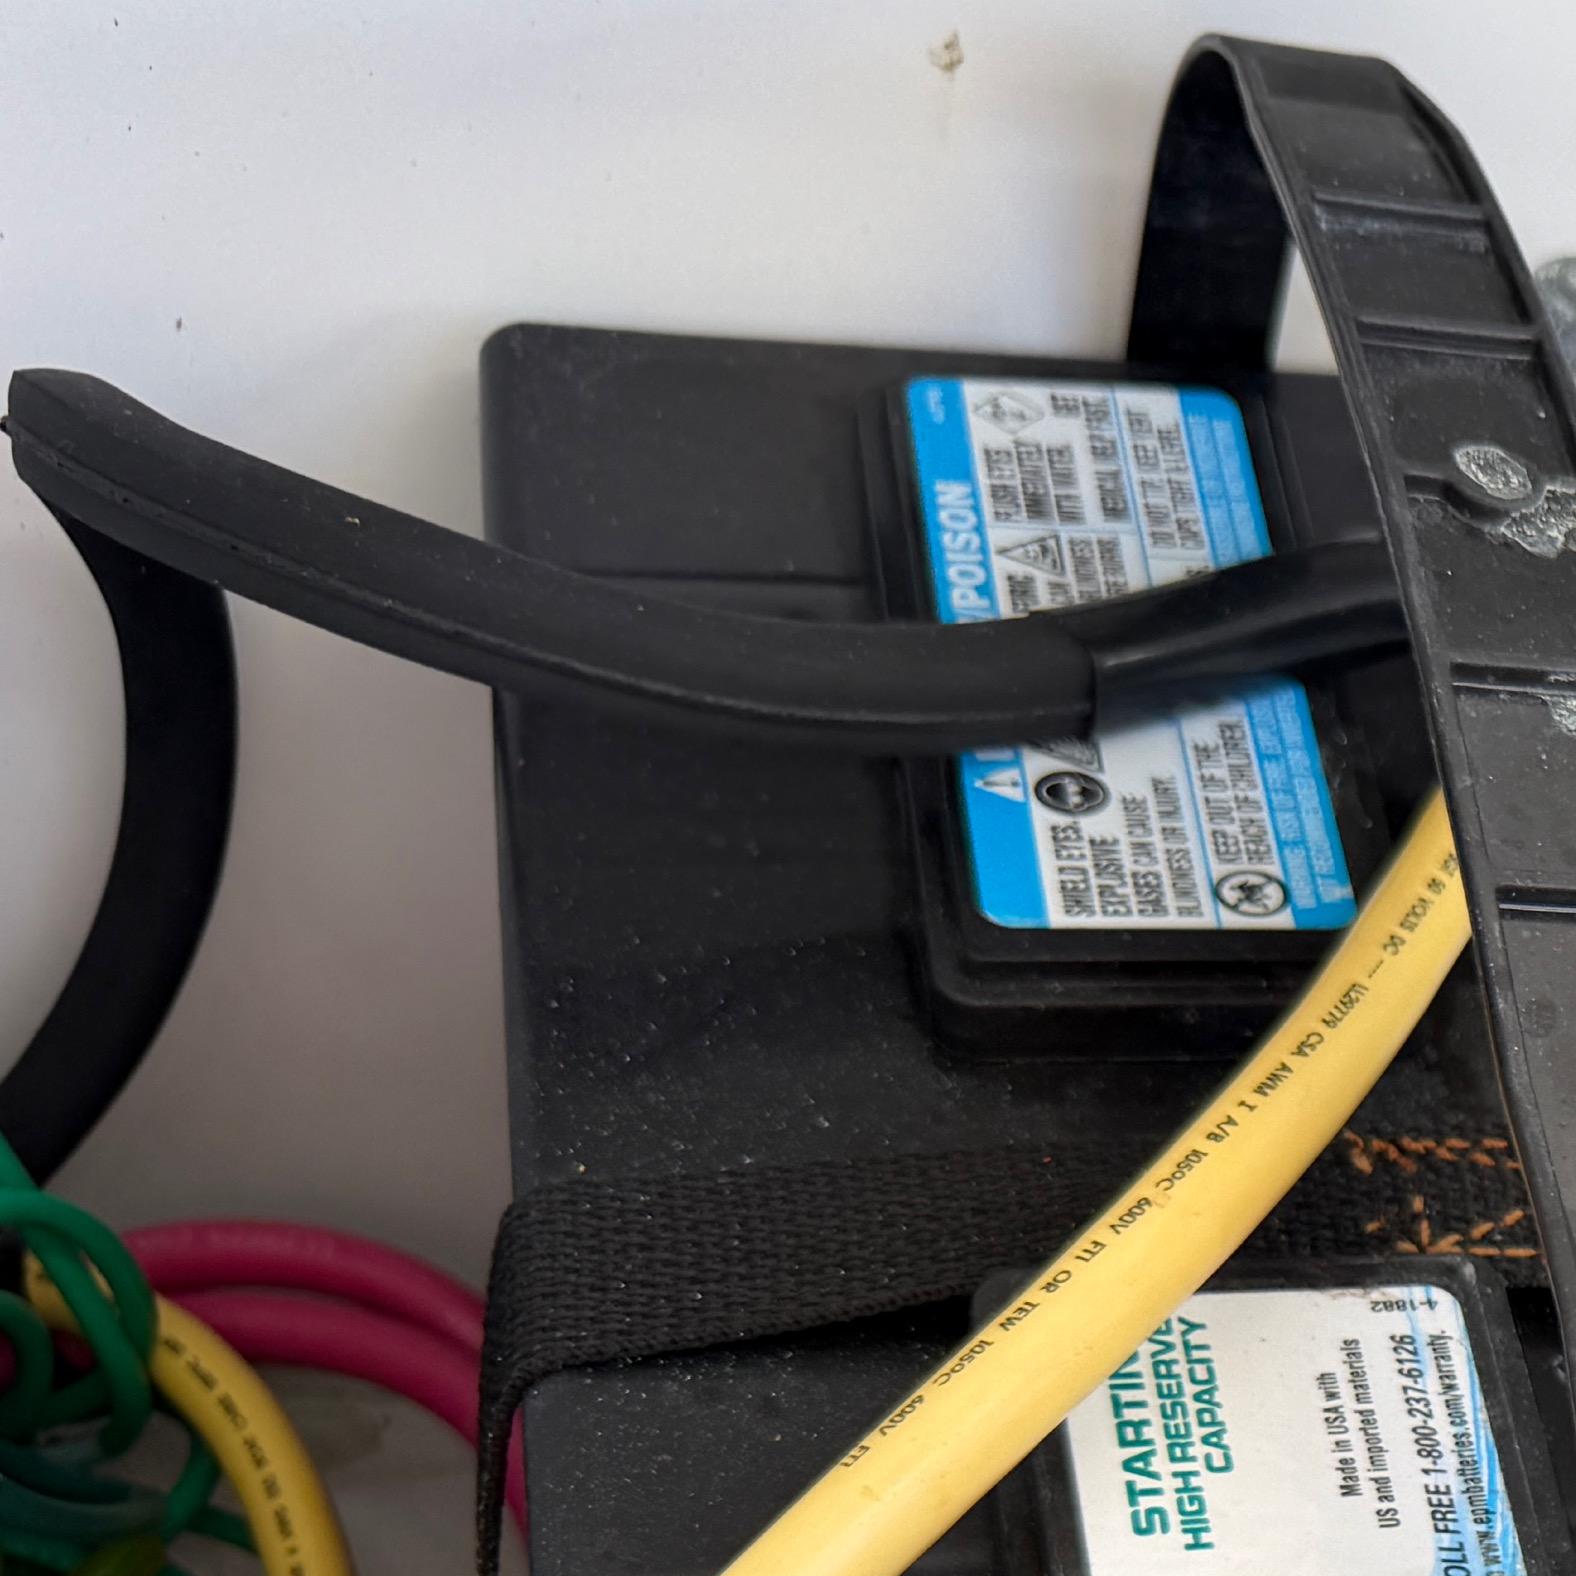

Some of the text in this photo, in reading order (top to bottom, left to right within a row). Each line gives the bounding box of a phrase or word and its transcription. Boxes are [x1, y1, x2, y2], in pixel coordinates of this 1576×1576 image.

[1382, 933, 1407, 956] DC
[1291, 1031, 1324, 1059] CSA
[1252, 1061, 1294, 1097] AWM
[1205, 1114, 1239, 1143] A/B
[1109, 1196, 1153, 1235] 600V
[1039, 1268, 1073, 1294] OR
[999, 1300, 1041, 1332] TEW
[877, 1394, 925, 1437] 600V
[1176, 1315, 1236, 1475] CAPACITY
[1389, 1333, 1449, 1477] 1-800-237-6126
[1108, 1350, 1172, 1538] STARTIN
[1314, 1370, 1364, 1499] Made in USA with
[1340, 1337, 1403, 1530] US and imported materials
[1170, 1470, 1215, 1551] HIGH
[1424, 1483, 1461, 1537] FREE
